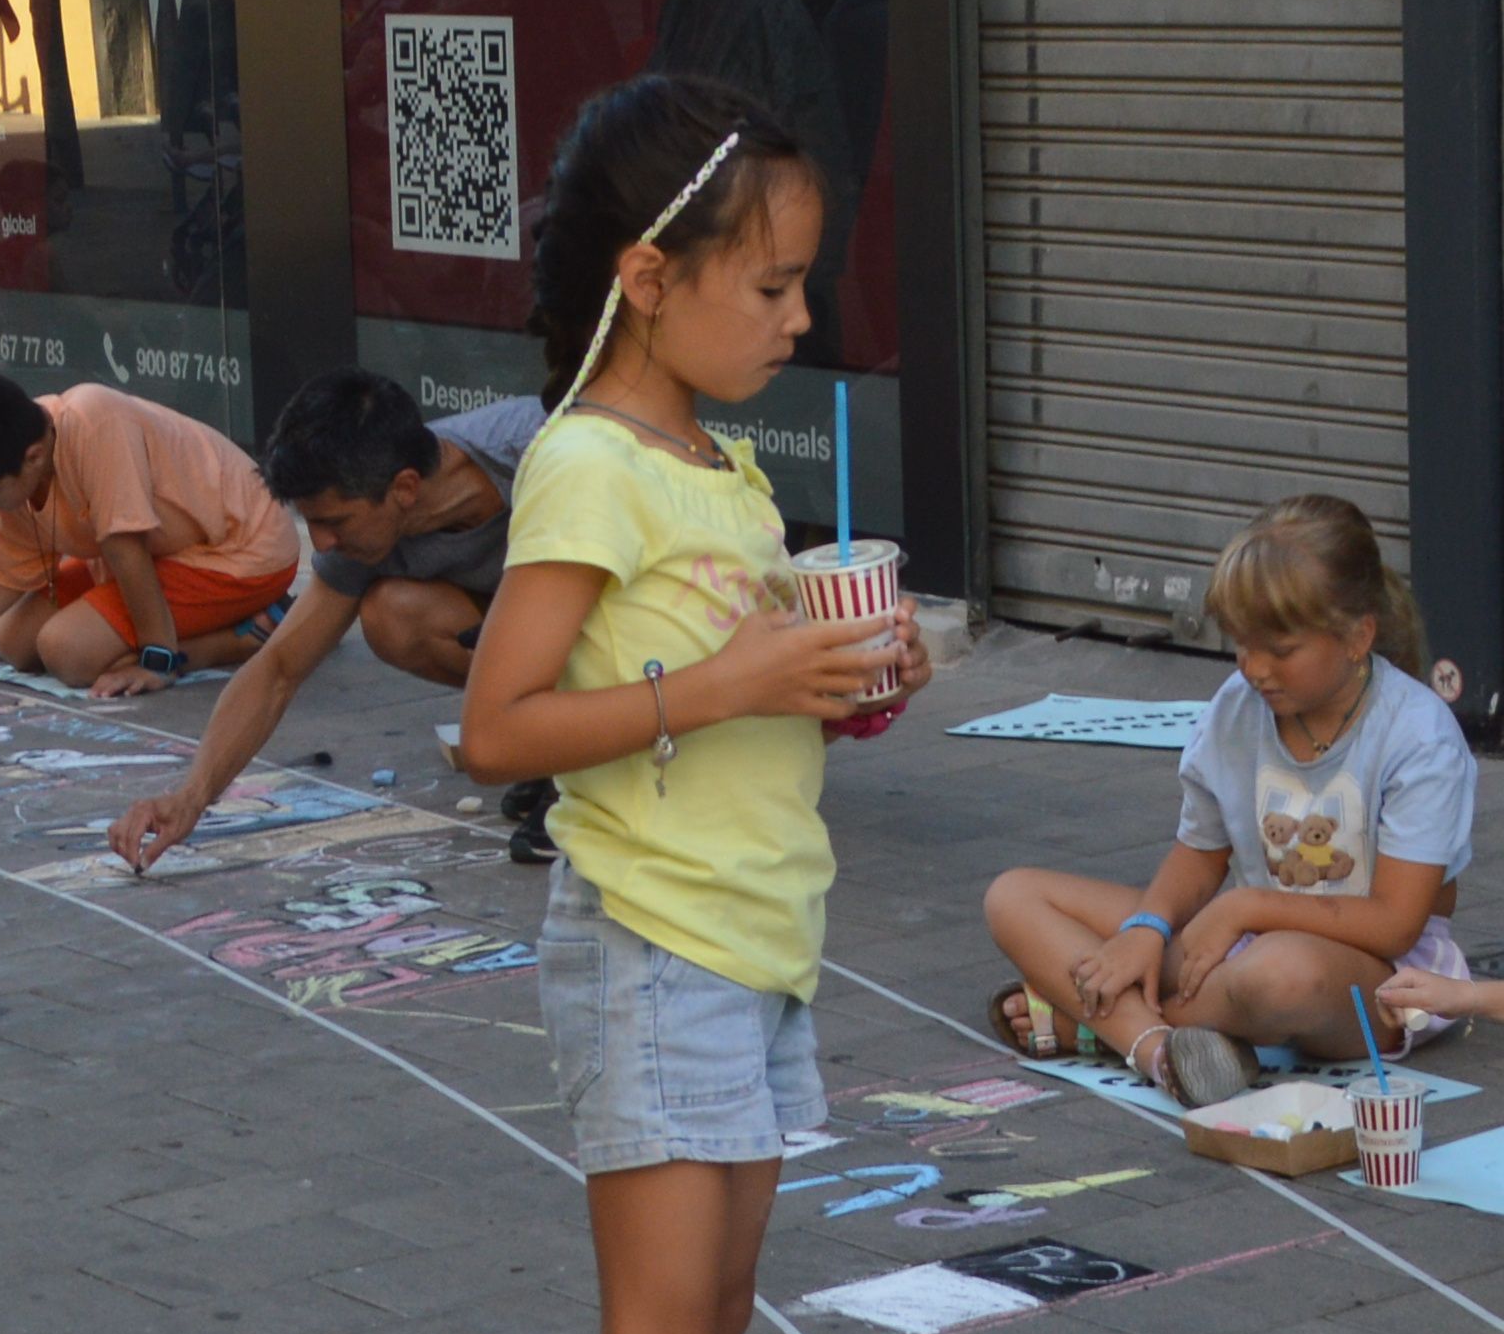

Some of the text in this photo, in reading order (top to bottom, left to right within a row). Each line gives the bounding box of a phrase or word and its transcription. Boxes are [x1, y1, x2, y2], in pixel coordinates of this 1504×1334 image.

[0, 213, 36, 238] global
[0, 334, 18, 361] 67
[22, 336, 42, 364] 77
[45, 338, 66, 366] 83
[135, 346, 241, 386] 900 87 74 63
